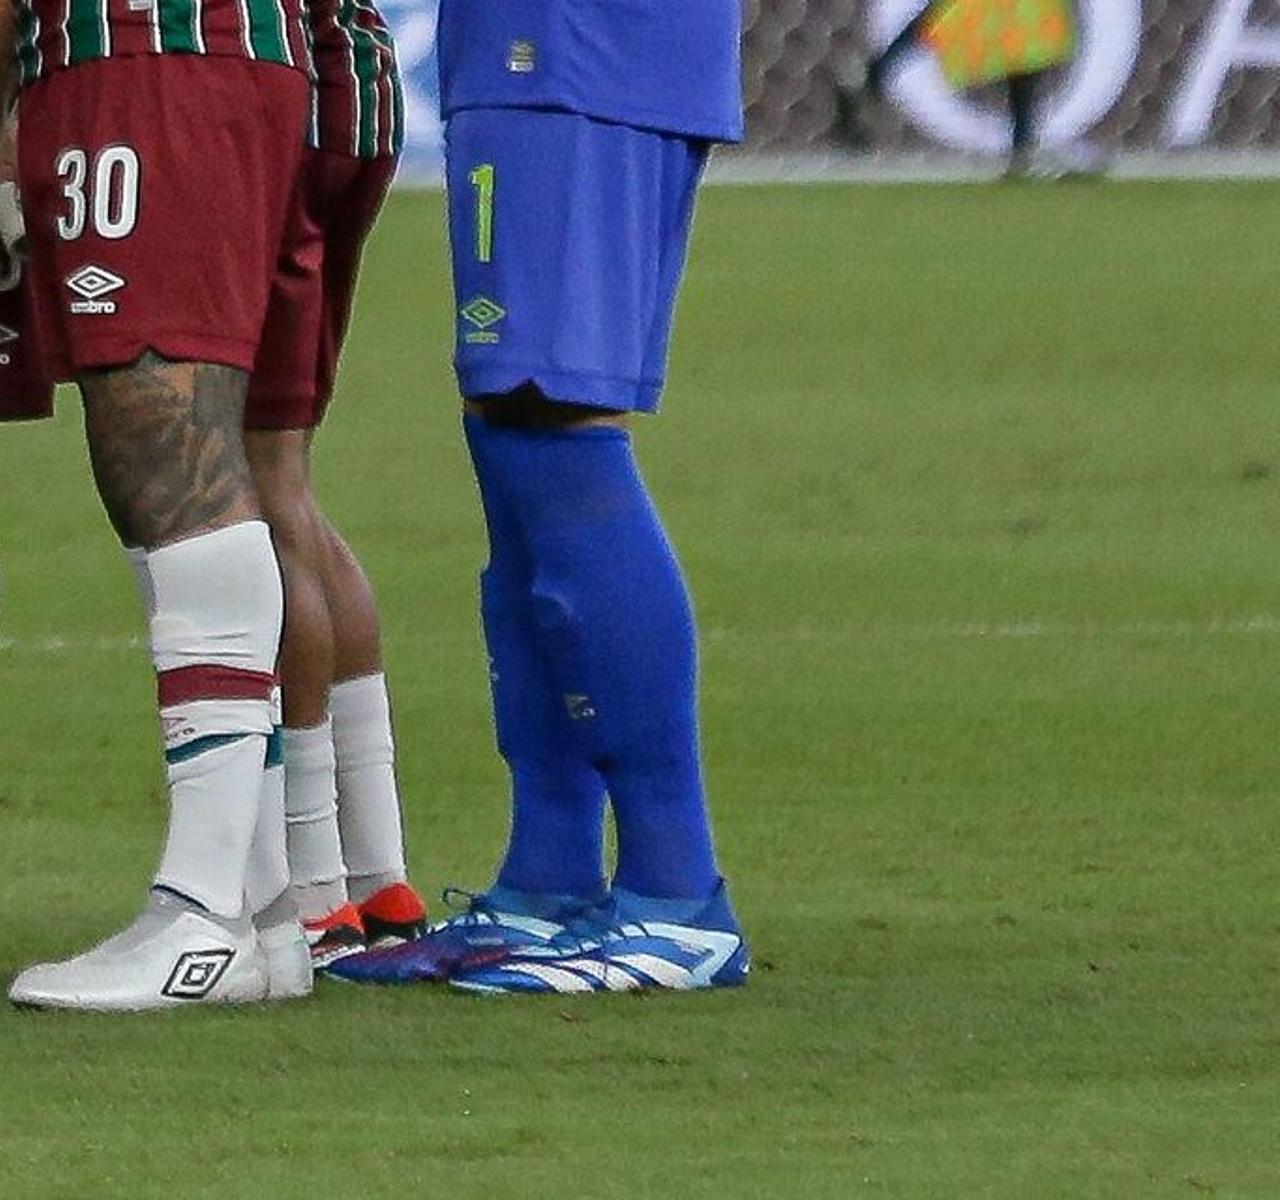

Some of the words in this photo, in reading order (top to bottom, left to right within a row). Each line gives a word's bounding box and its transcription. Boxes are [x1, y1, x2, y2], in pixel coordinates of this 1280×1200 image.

[57, 145, 139, 240] 30
[469, 164, 494, 263] 1
[70, 300, 116, 315] umbro
